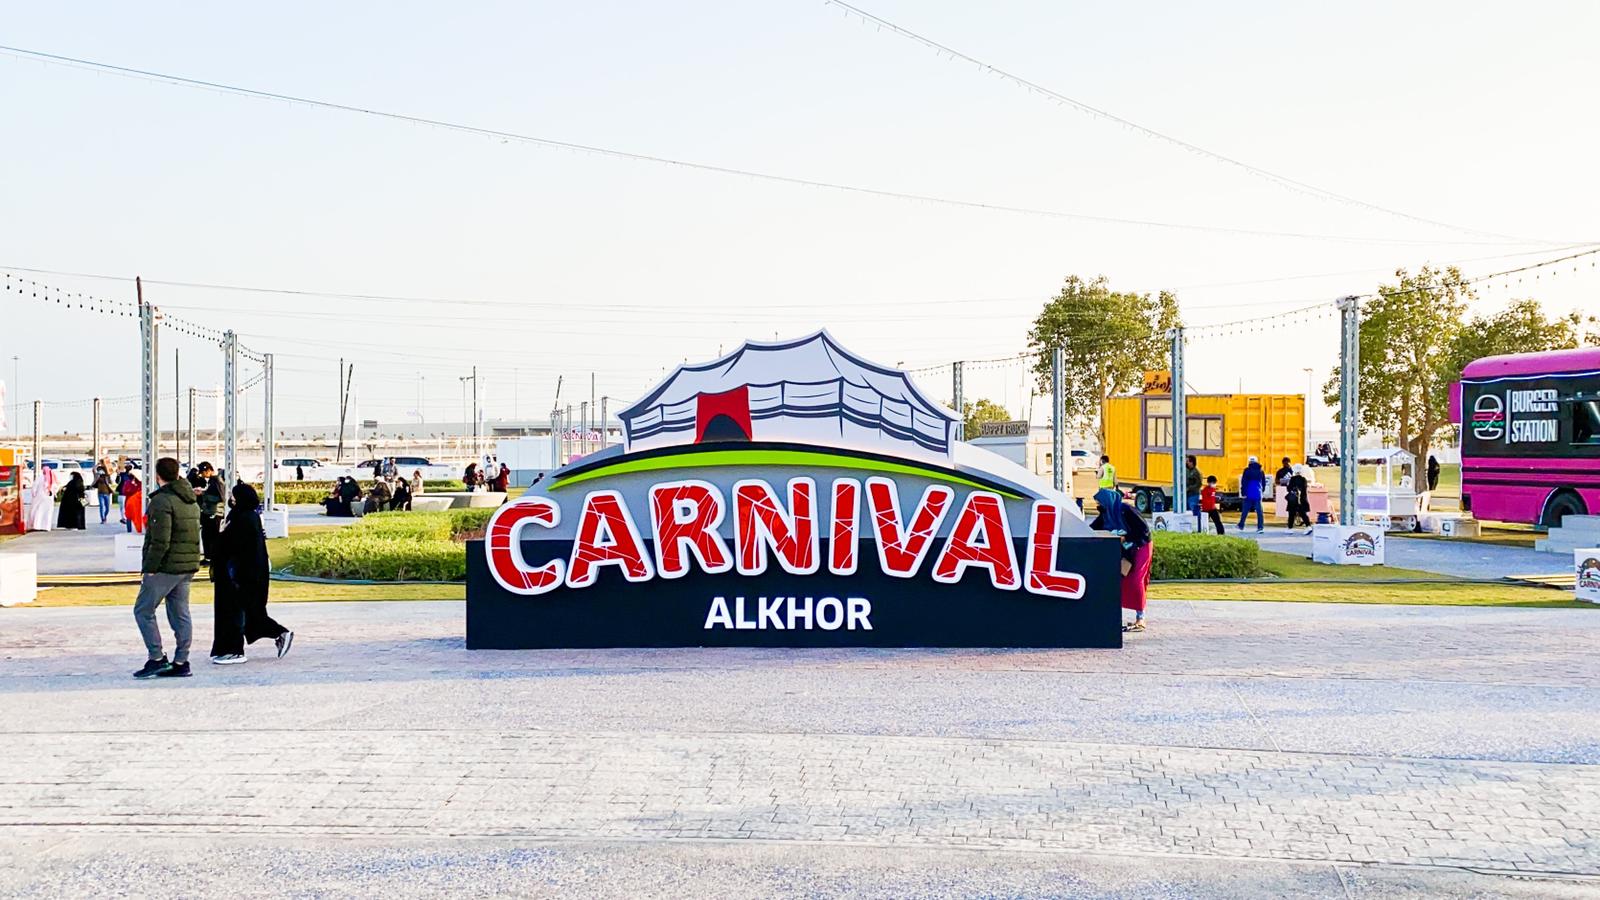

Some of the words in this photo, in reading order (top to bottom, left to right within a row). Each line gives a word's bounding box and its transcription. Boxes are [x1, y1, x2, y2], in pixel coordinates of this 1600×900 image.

[1511, 389, 1559, 412] BURGER
[1511, 419, 1559, 442] STATION
[484, 476, 1087, 600] CARNIVAL
[1345, 549, 1375, 557] CARNIVAL
[1579, 580, 1600, 589] CARNIV
[703, 596, 874, 630] ALKHOR
